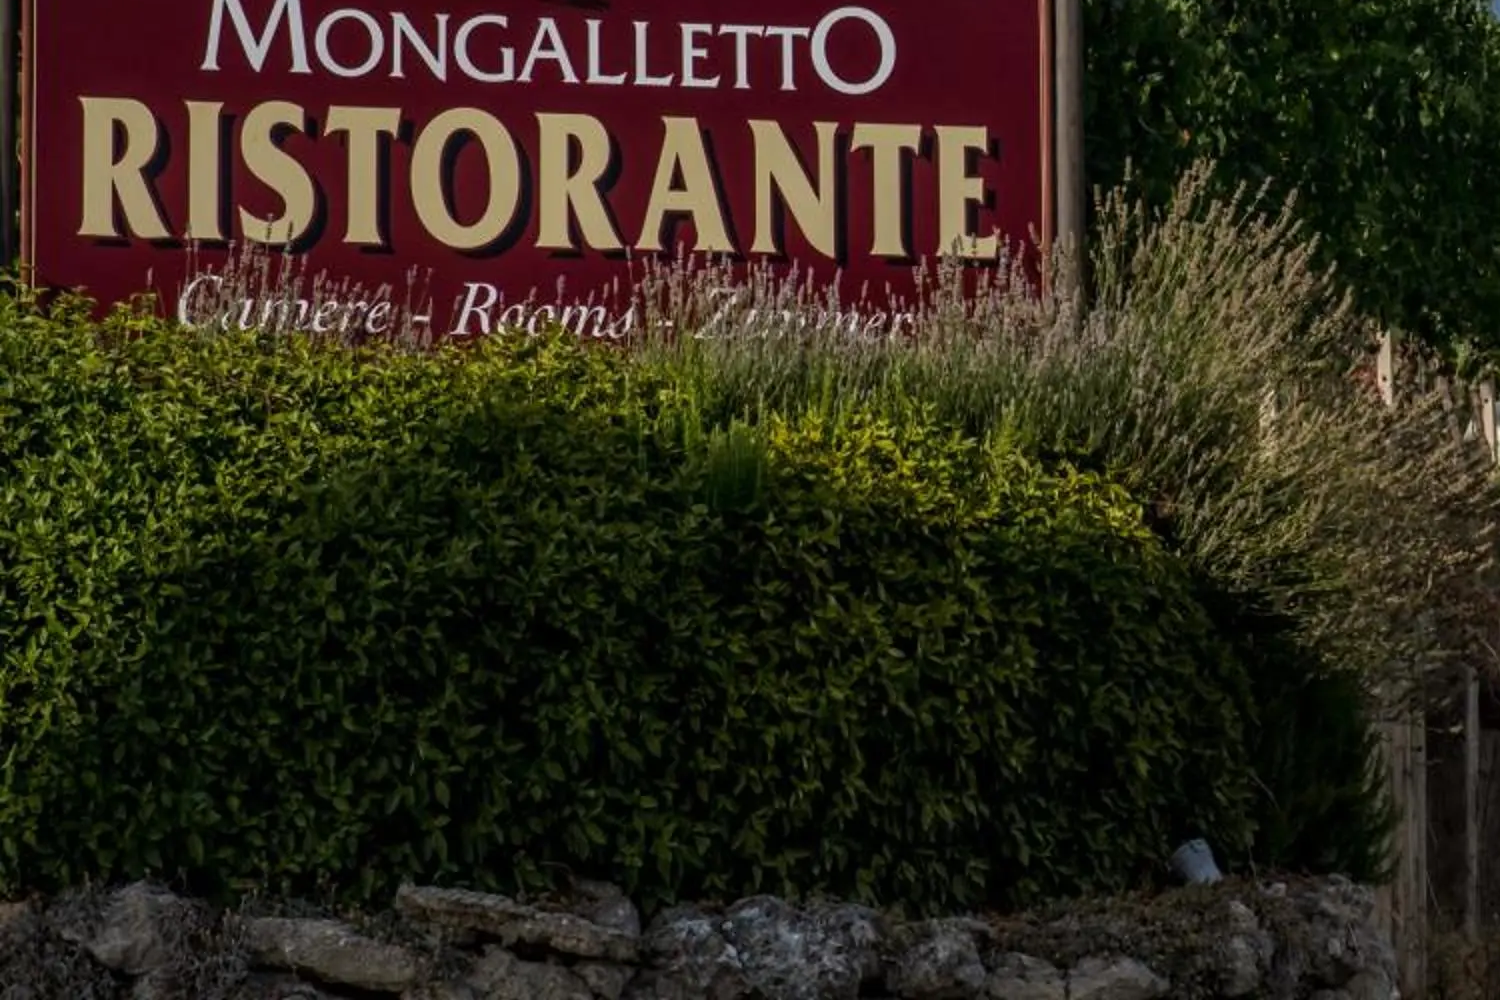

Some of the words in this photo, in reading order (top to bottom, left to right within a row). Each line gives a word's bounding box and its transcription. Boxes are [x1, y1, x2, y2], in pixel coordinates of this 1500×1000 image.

[77, 96, 1001, 260] RISTORANTE
[178, 275, 391, 333] Camere
[450, 282, 636, 338] Rooms
